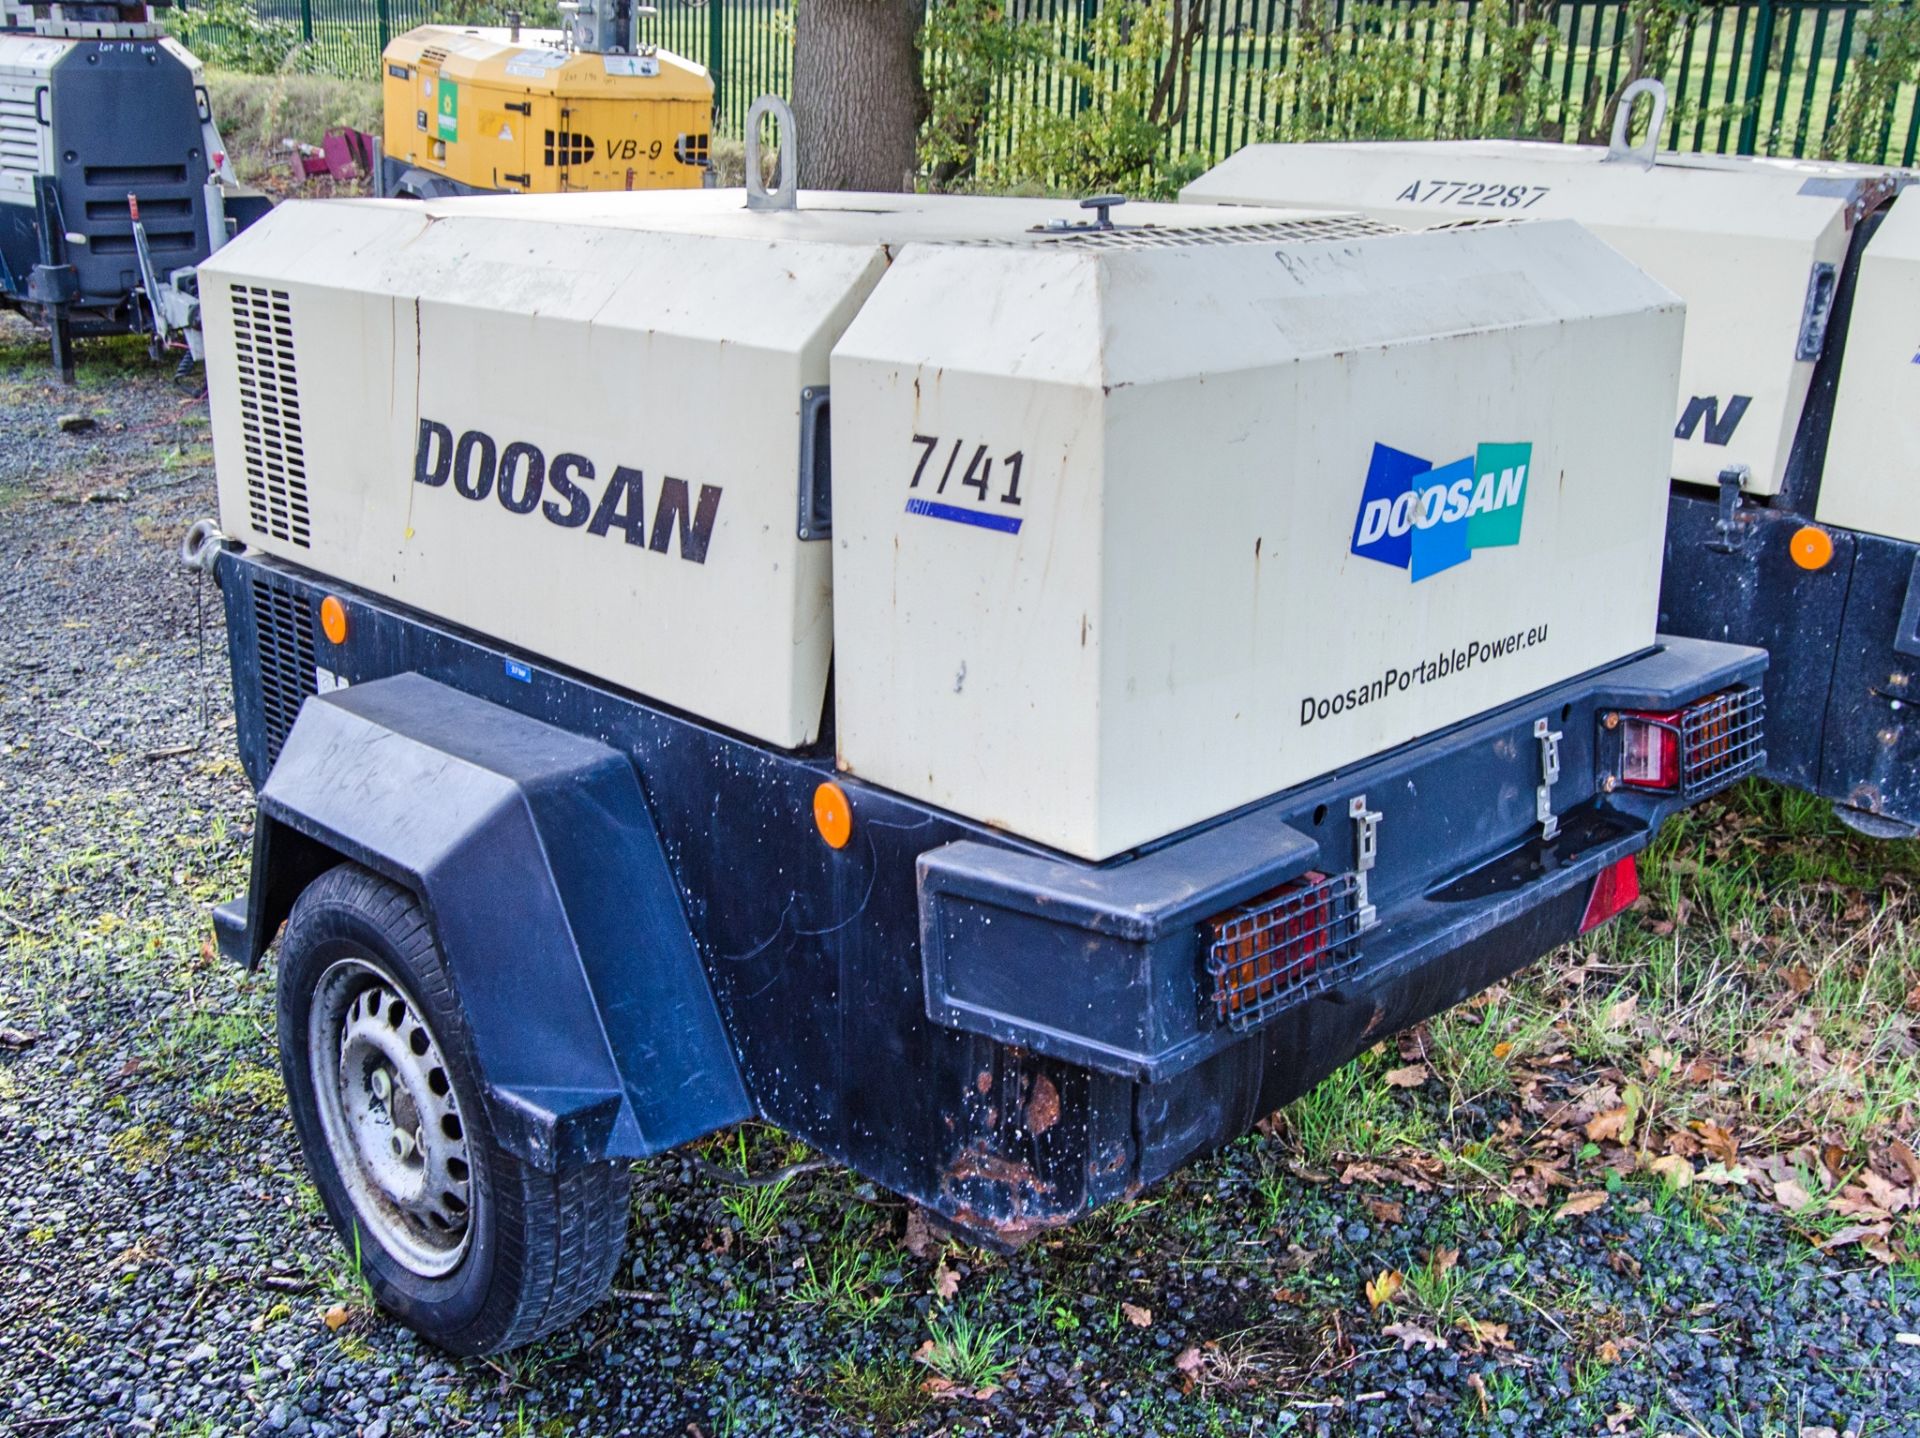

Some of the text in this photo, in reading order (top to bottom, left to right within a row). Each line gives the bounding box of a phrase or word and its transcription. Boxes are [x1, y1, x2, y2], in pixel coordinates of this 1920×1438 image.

[606, 139, 663, 160] VB-9
[414, 418, 723, 565] DOOSAN
[909, 433, 1024, 505] 7/41
[1356, 464, 1527, 547] DOOSAN
[1300, 623, 1549, 727] DoosanPortablePower.eu
